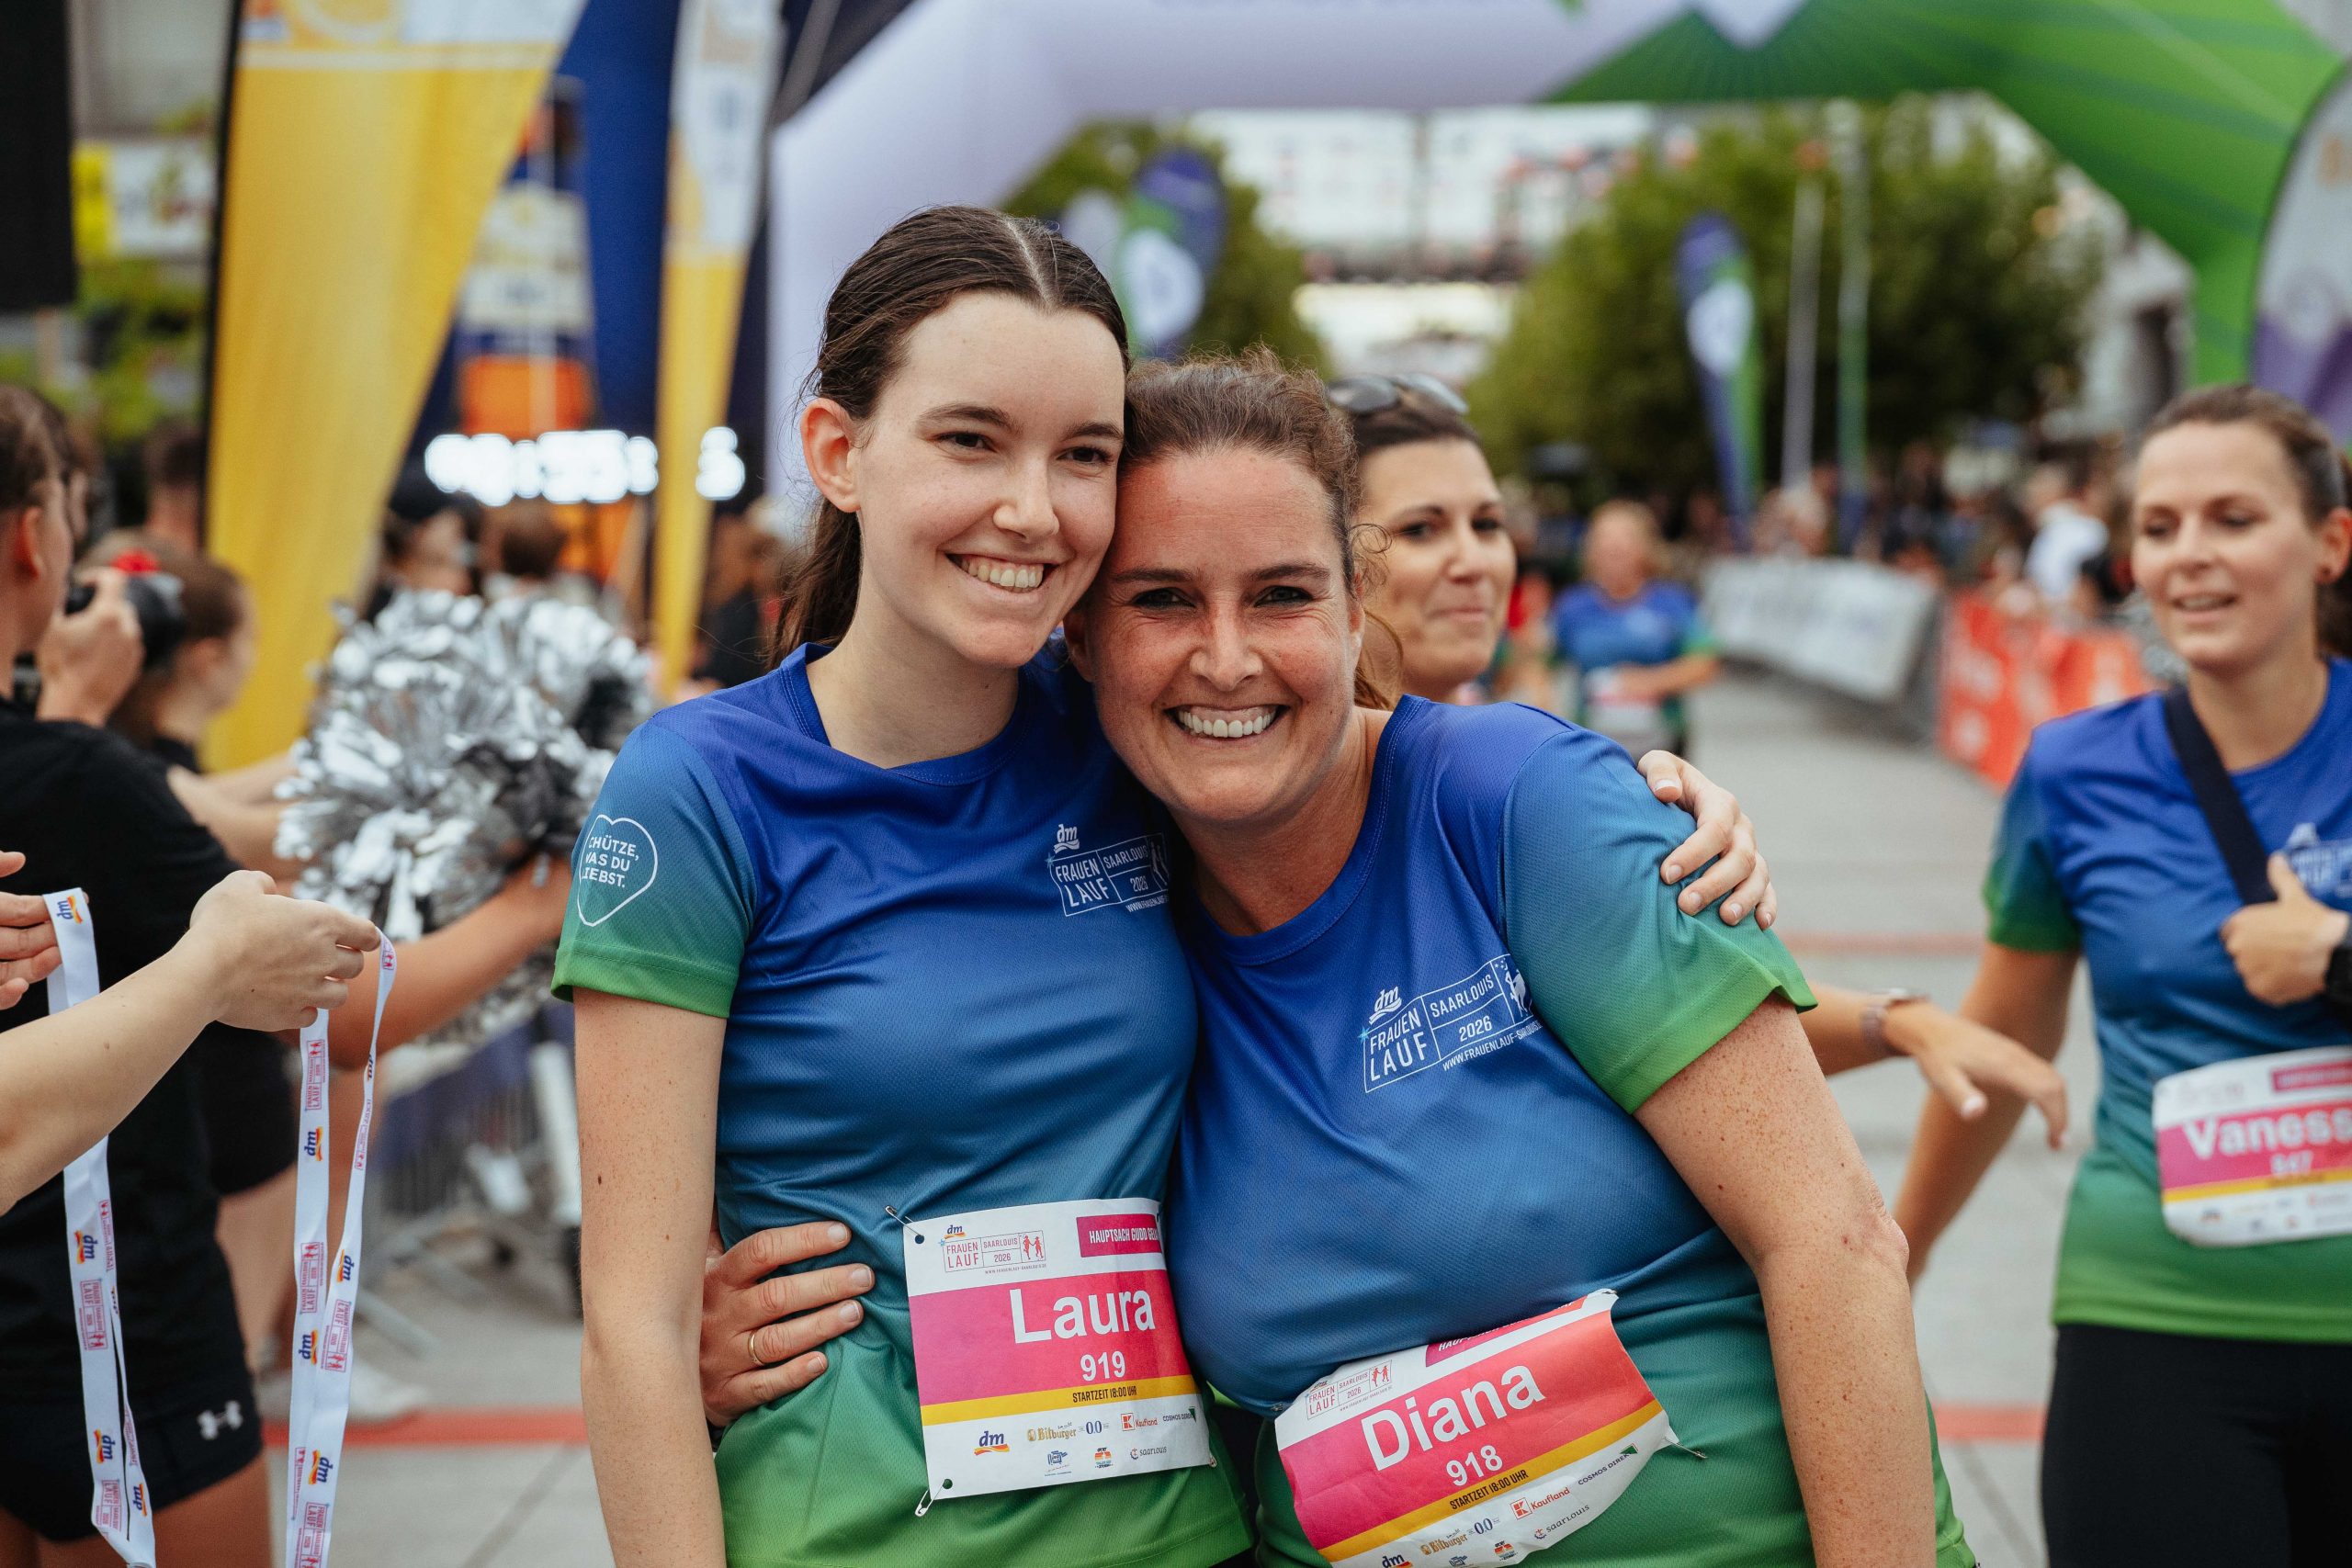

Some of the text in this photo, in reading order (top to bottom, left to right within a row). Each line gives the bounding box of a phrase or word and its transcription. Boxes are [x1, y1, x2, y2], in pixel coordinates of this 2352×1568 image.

[1057, 824, 1078, 842] dm
[611, 856, 630, 872] DU
[1055, 845, 1148, 883] FRAUEN SAARLOUIS
[1064, 878, 1110, 908] LAUF
[57, 900, 74, 919] dm
[1374, 986, 1398, 1012] dm
[1370, 974, 1495, 1055] FRAUEN SAARLOUIS
[1370, 1015, 1492, 1082] LAUF 2026
[304, 1131, 316, 1156] dm
[946, 1224, 963, 1235] dm
[1089, 1229, 1130, 1244] HAUPTSACH
[83, 1235, 97, 1259] dm
[946, 1237, 1018, 1255] FRAUEN SAARLOUIS
[343, 1255, 355, 1281] dm
[947, 1253, 1012, 1269] LAUF 2026
[83, 1282, 94, 1304] LAUF
[334, 1303, 345, 1325] LAUF
[1010, 1288, 1156, 1344] Laura
[299, 1334, 311, 1359] dm
[1080, 1351, 1126, 1382] 919
[1072, 1385, 1137, 1403] STARTZEIT 18:00 UHR
[1308, 1385, 1335, 1404] FRAUEN
[1339, 1371, 1368, 1389] SAARLOUIS
[1309, 1386, 1362, 1415] LAUF 2026
[1135, 1417, 1158, 1427] Kaufland
[1162, 1414, 1182, 1422] COSMOS
[1361, 1365, 1547, 1471] Diana
[978, 1430, 1004, 1447] dm
[1037, 1427, 1077, 1441] Bitburger
[102, 1435, 116, 1460] dm
[317, 1456, 334, 1483] dm
[1446, 1444, 1503, 1487] 918
[1577, 1466, 1608, 1485] COSMOS
[133, 1486, 142, 1511] dm
[1449, 1469, 1529, 1510] STARTZEIT 18:00 UHR
[1531, 1486, 1570, 1511] Kaufland
[307, 1506, 317, 1528] LAUF
[316, 1506, 325, 1529] FRAUEN
[1429, 1532, 1468, 1554] Bitburger
[1474, 1517, 1493, 1535] 0.0
[1382, 1554, 1405, 1568] dm
